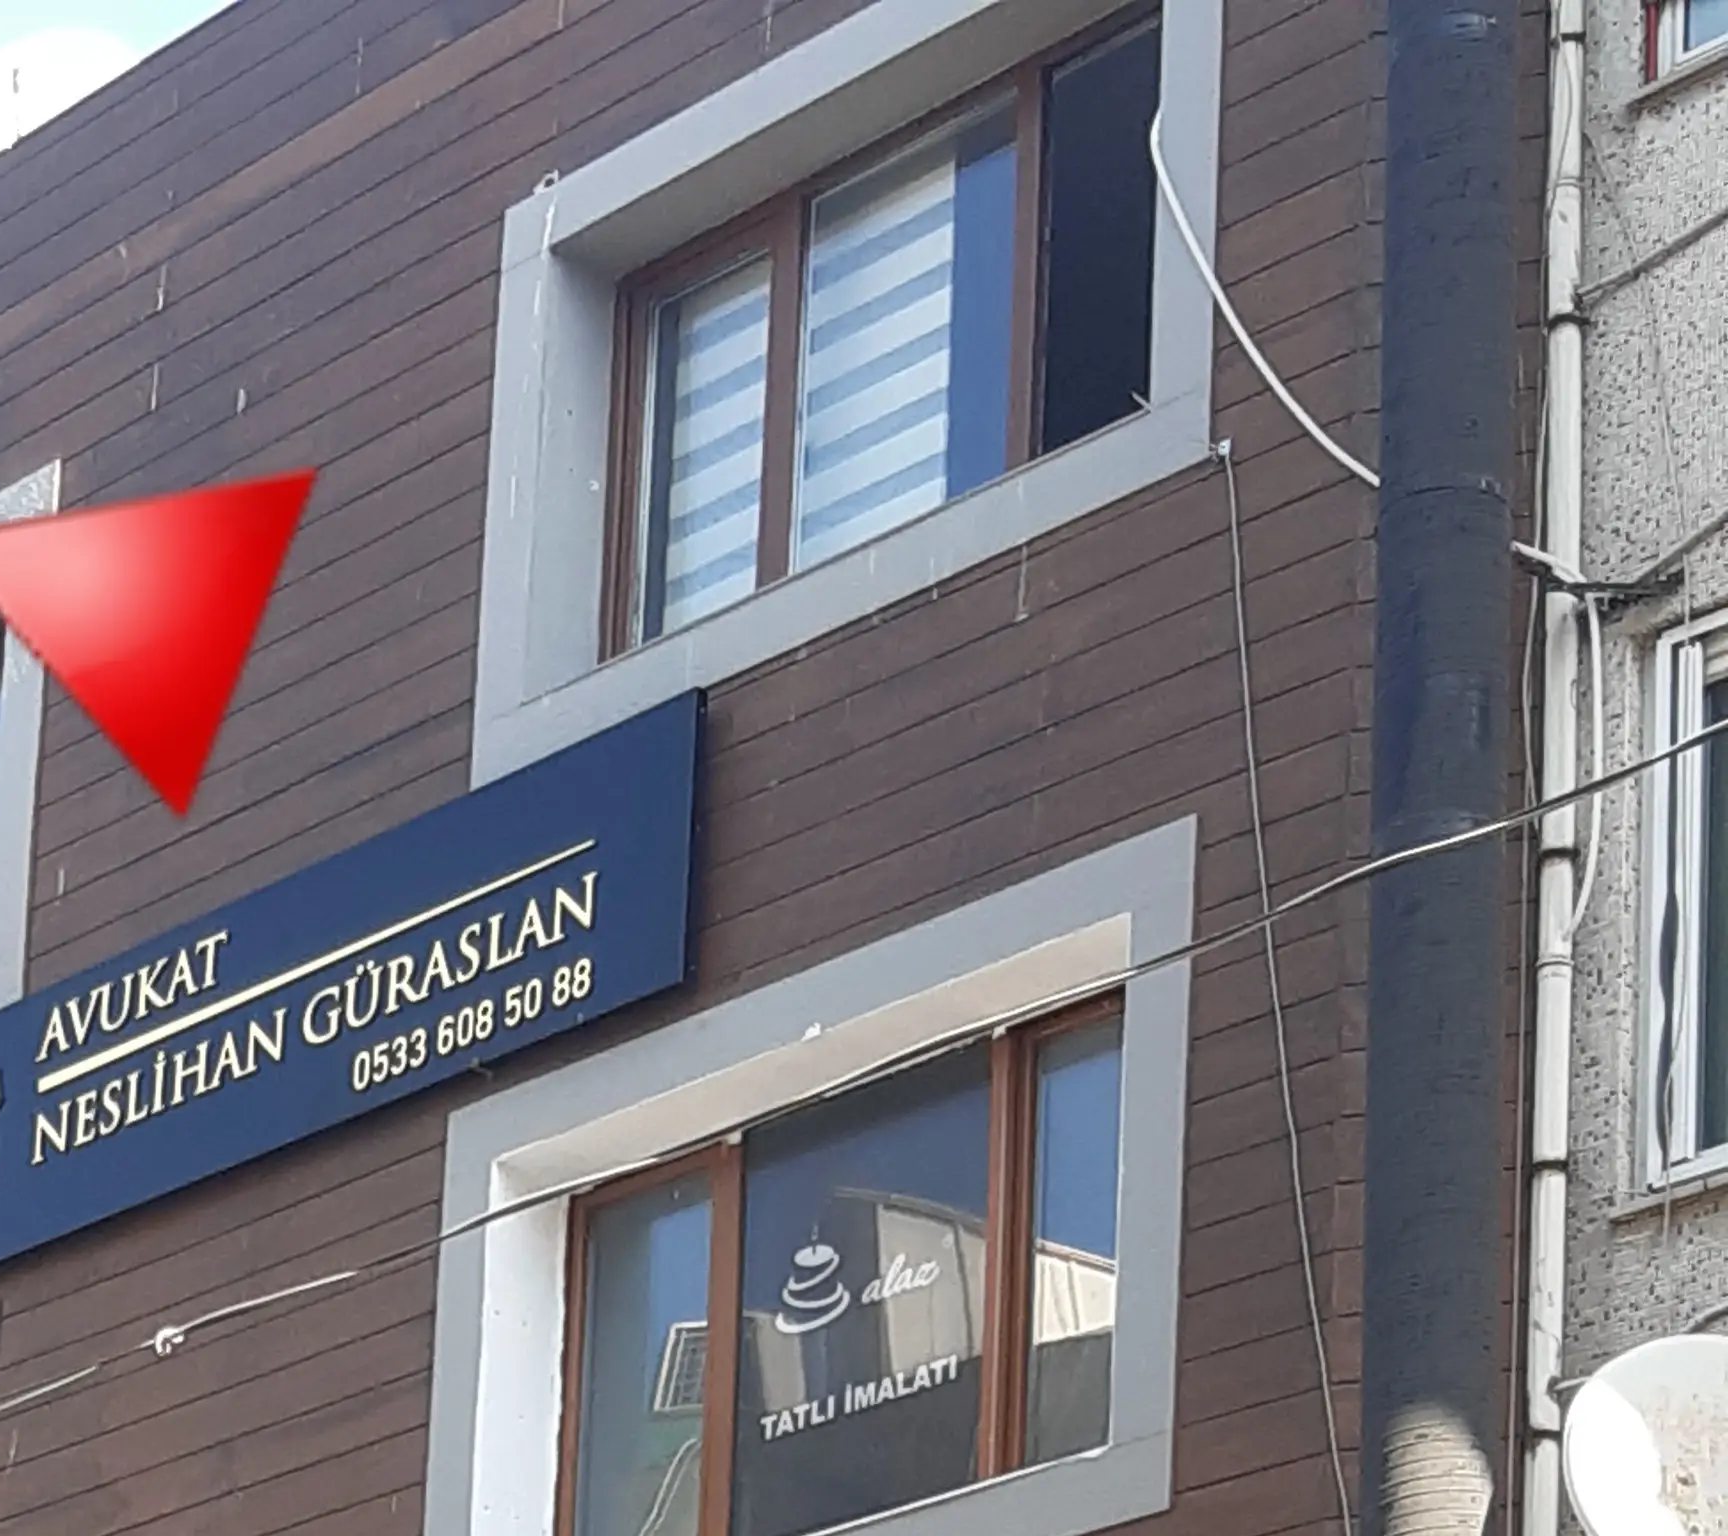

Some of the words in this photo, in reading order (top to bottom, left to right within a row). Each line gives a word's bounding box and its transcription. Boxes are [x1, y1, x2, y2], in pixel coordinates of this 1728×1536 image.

[31, 1007, 287, 1165] NESLİHAN
[301, 871, 598, 1044] GÜRASLAN
[34, 929, 230, 1063] AVUKAT
[352, 1027, 427, 1091] 0533
[436, 999, 494, 1055] 608
[504, 978, 542, 1027] 50
[552, 957, 592, 1006] 88
[761, 1395, 835, 1441] TATLI
[844, 1354, 959, 1416] İMALATI
